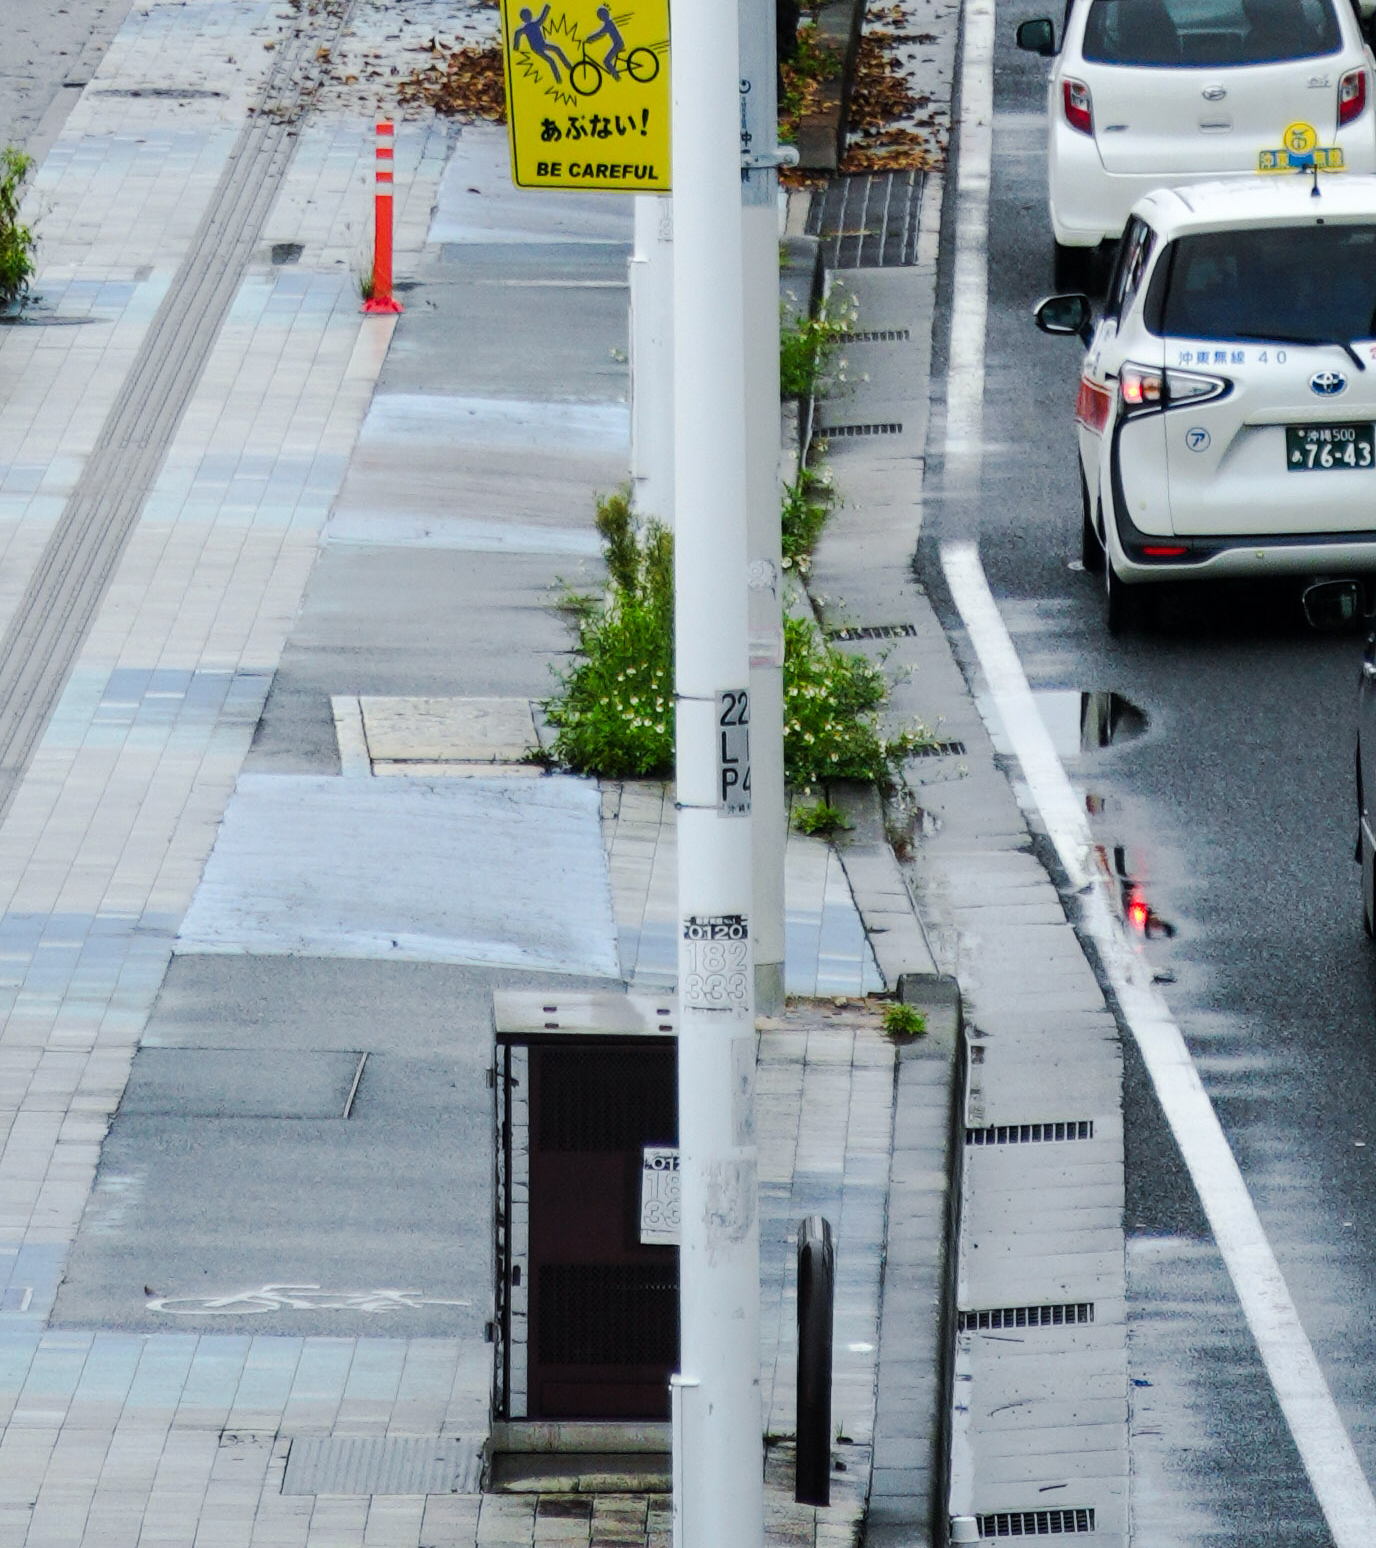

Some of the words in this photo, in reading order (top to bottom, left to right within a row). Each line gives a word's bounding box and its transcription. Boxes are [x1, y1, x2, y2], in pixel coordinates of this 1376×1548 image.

[540, 108, 649, 142] あぶない!
[536, 162, 562, 178] BE
[569, 162, 659, 180] CAREFUL
[1178, 350, 1245, 366] 沖東無線
[1257, 350, 1288, 365] 40
[1307, 428, 1356, 443] 沖縄500
[1304, 442, 1372, 469] 76-43
[688, 924, 743, 940] 0120
[685, 941, 748, 973] 182
[685, 973, 748, 1005] 333
